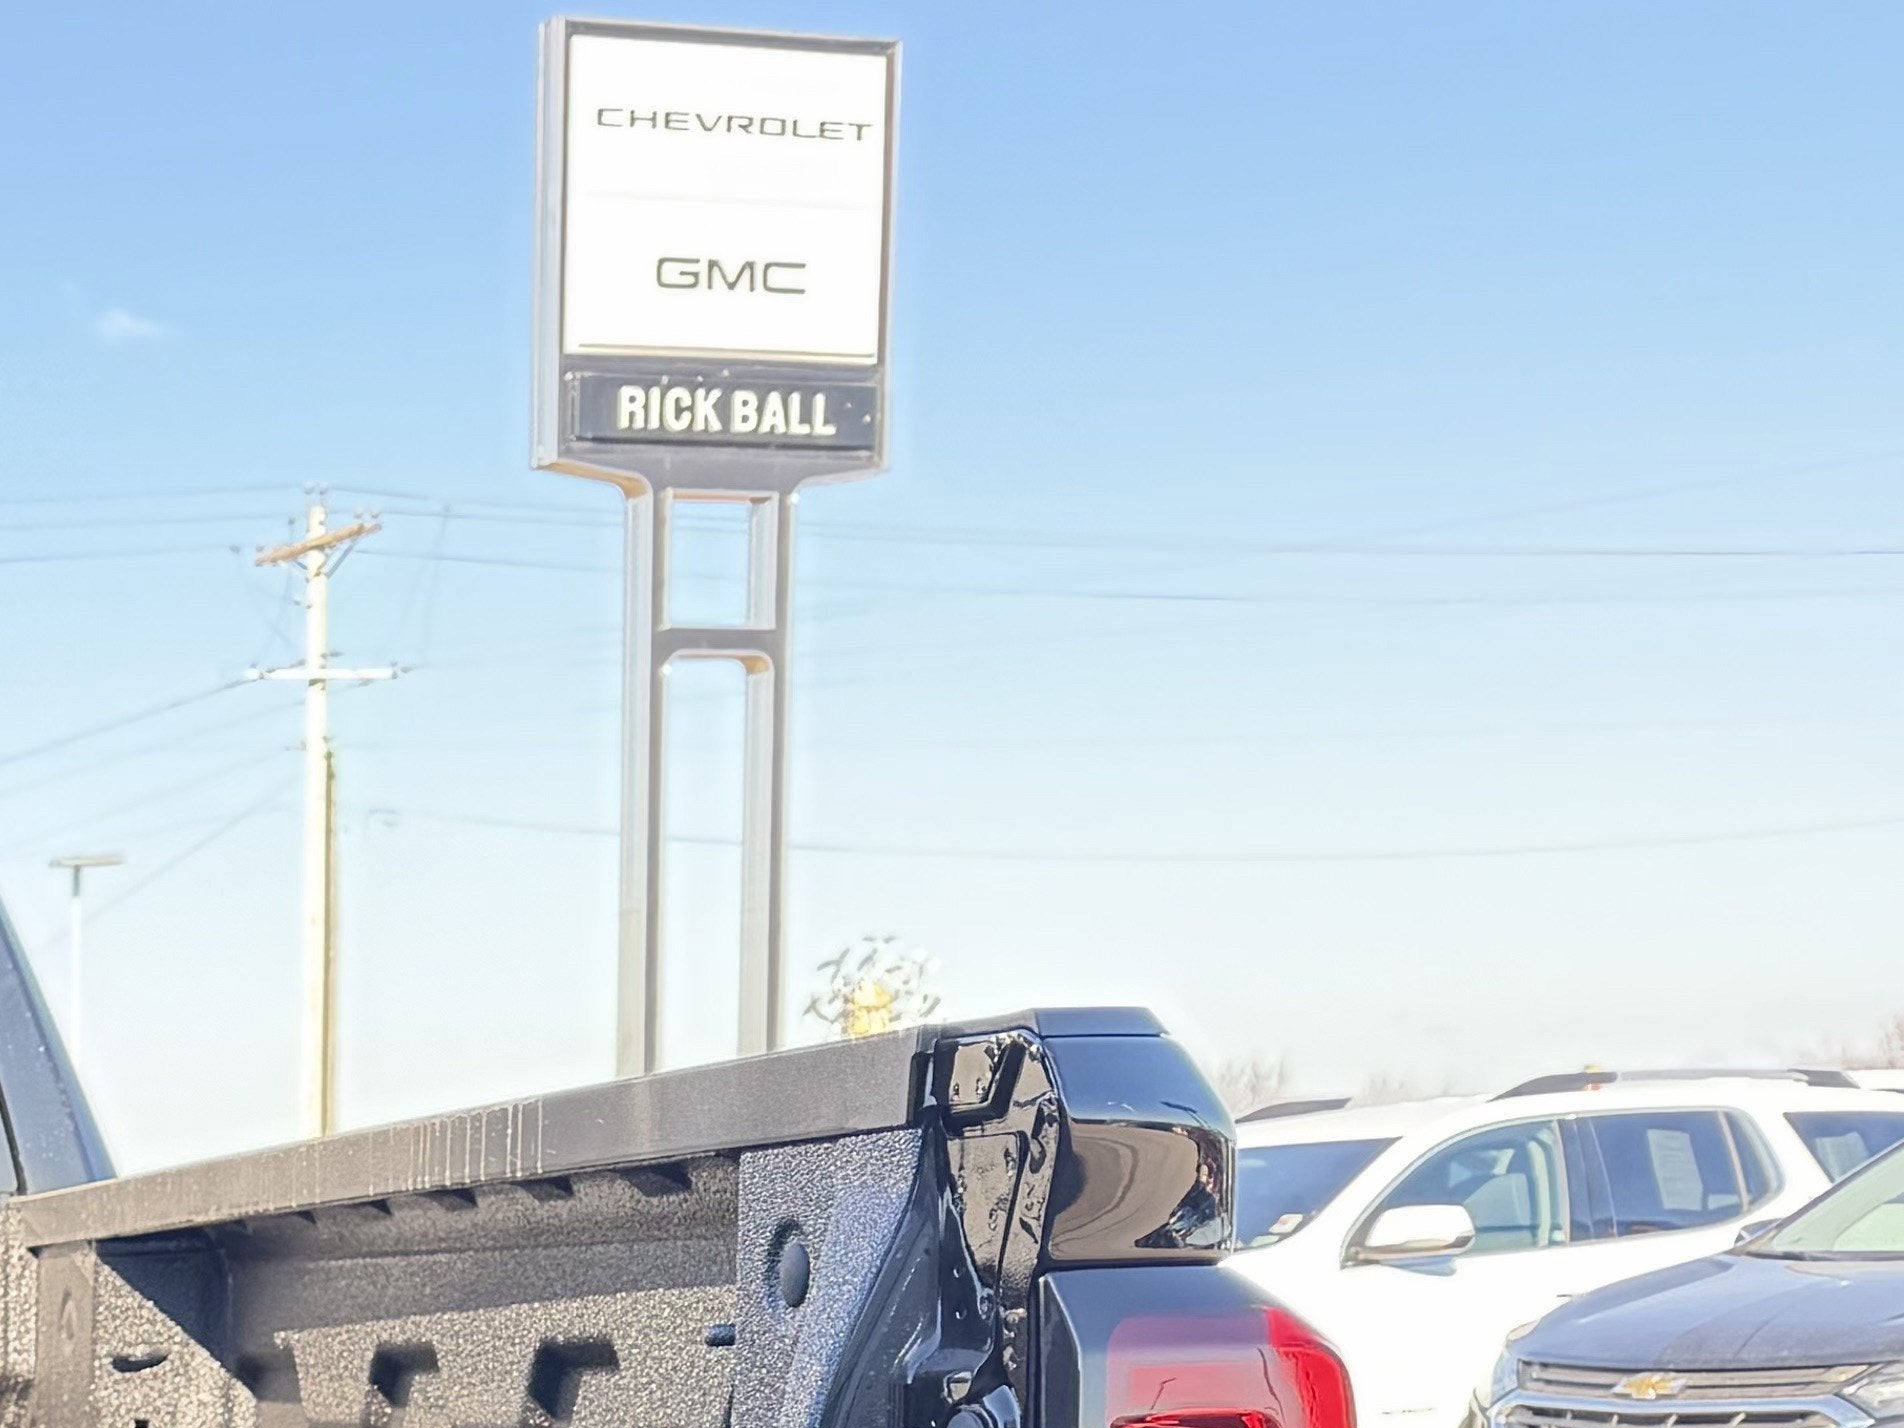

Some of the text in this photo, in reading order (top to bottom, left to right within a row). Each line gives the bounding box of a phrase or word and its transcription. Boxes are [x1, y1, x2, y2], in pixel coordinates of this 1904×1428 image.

[597, 108, 872, 141] CHEVROLET
[656, 257, 807, 295] GMC
[618, 385, 838, 436] RICK BALL
